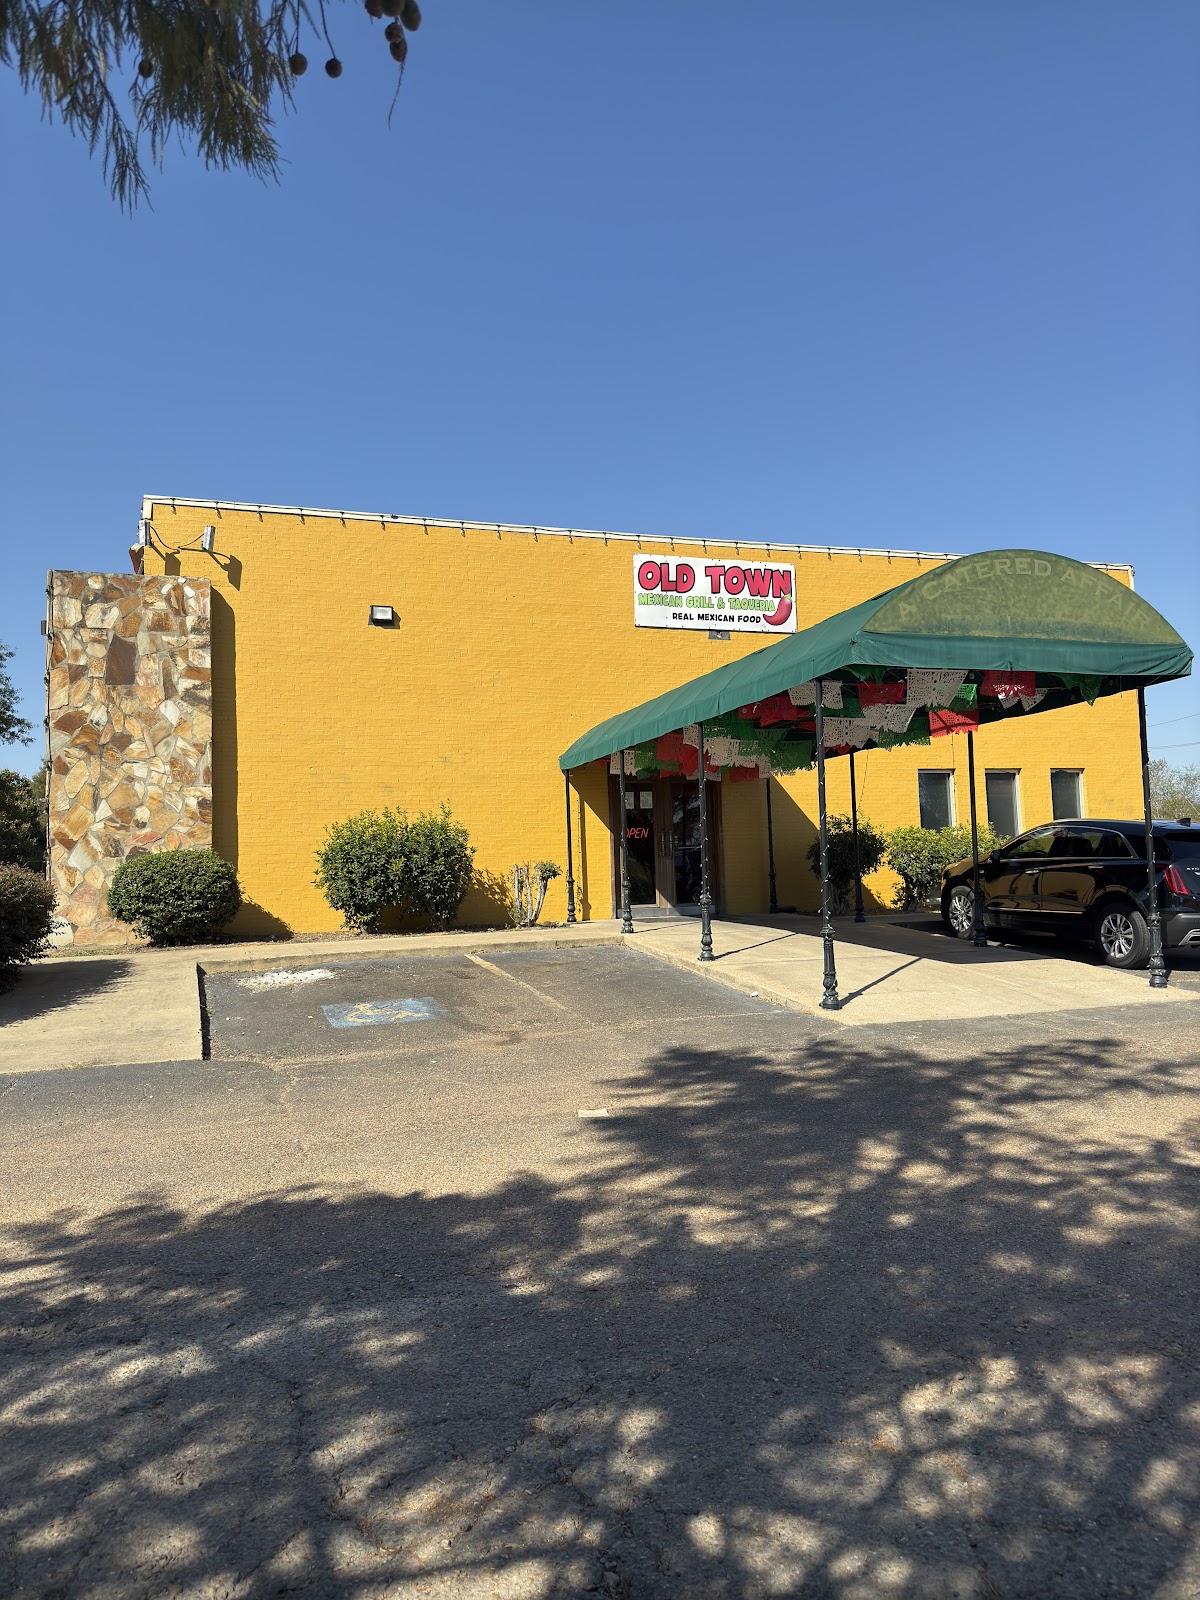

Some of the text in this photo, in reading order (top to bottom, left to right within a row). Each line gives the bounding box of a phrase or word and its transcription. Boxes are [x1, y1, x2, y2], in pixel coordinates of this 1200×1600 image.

[638, 560, 792, 598] OLD TOWN
[638, 593, 775, 612] MEXICAN GRILL & TAQUERIA
[898, 557, 1151, 630] A CATERED AFFAIR
[672, 612, 761, 624] REAL MEXICAN FOOD
